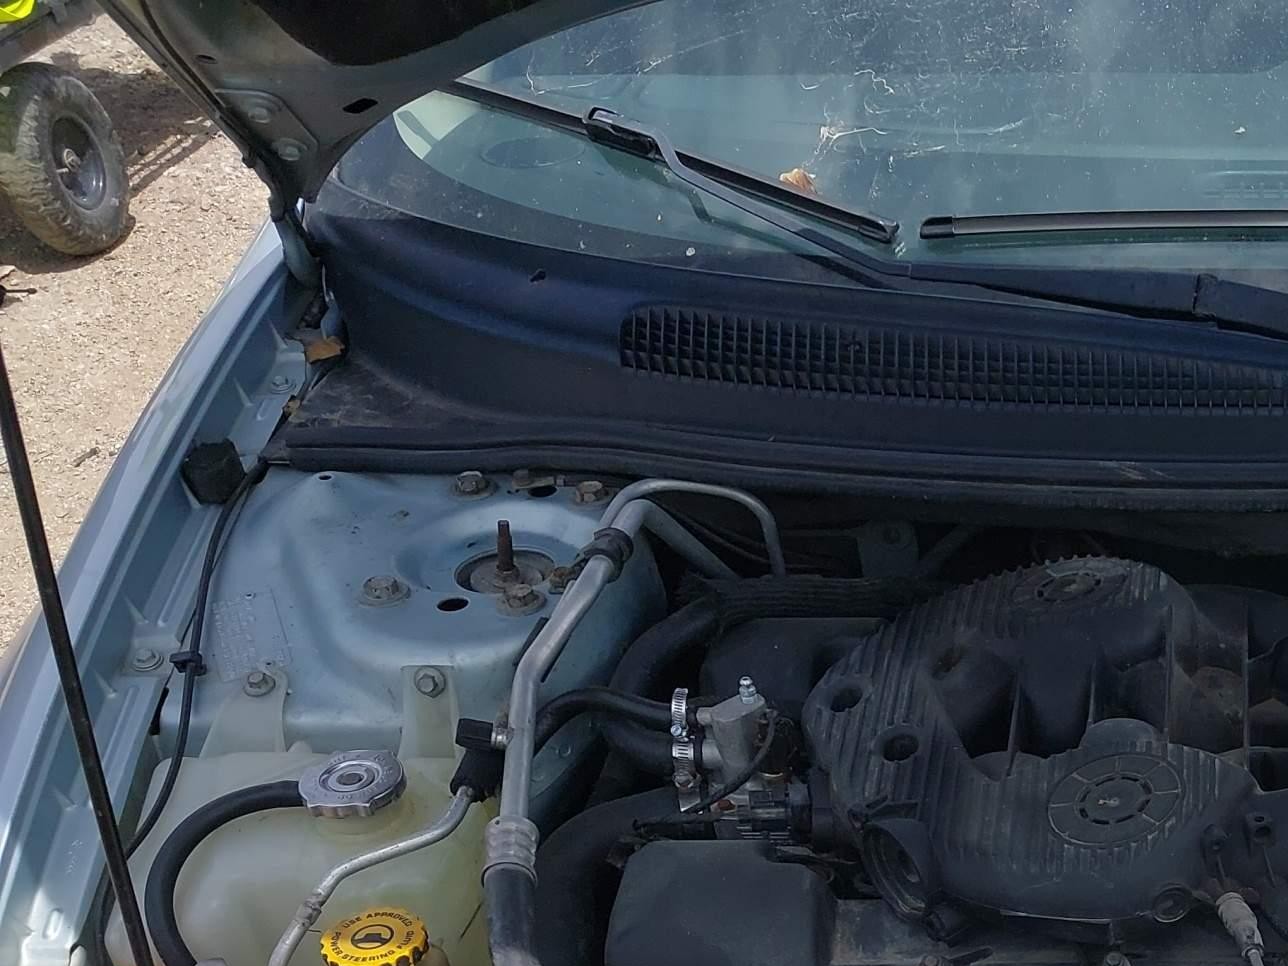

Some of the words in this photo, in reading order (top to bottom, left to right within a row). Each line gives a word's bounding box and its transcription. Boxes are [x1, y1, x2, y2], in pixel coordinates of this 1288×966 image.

[343, 916, 362, 928] USE
[366, 912, 412, 927] APPROVED
[330, 932, 342, 956] POWER
[342, 950, 395, 962] STEERING
